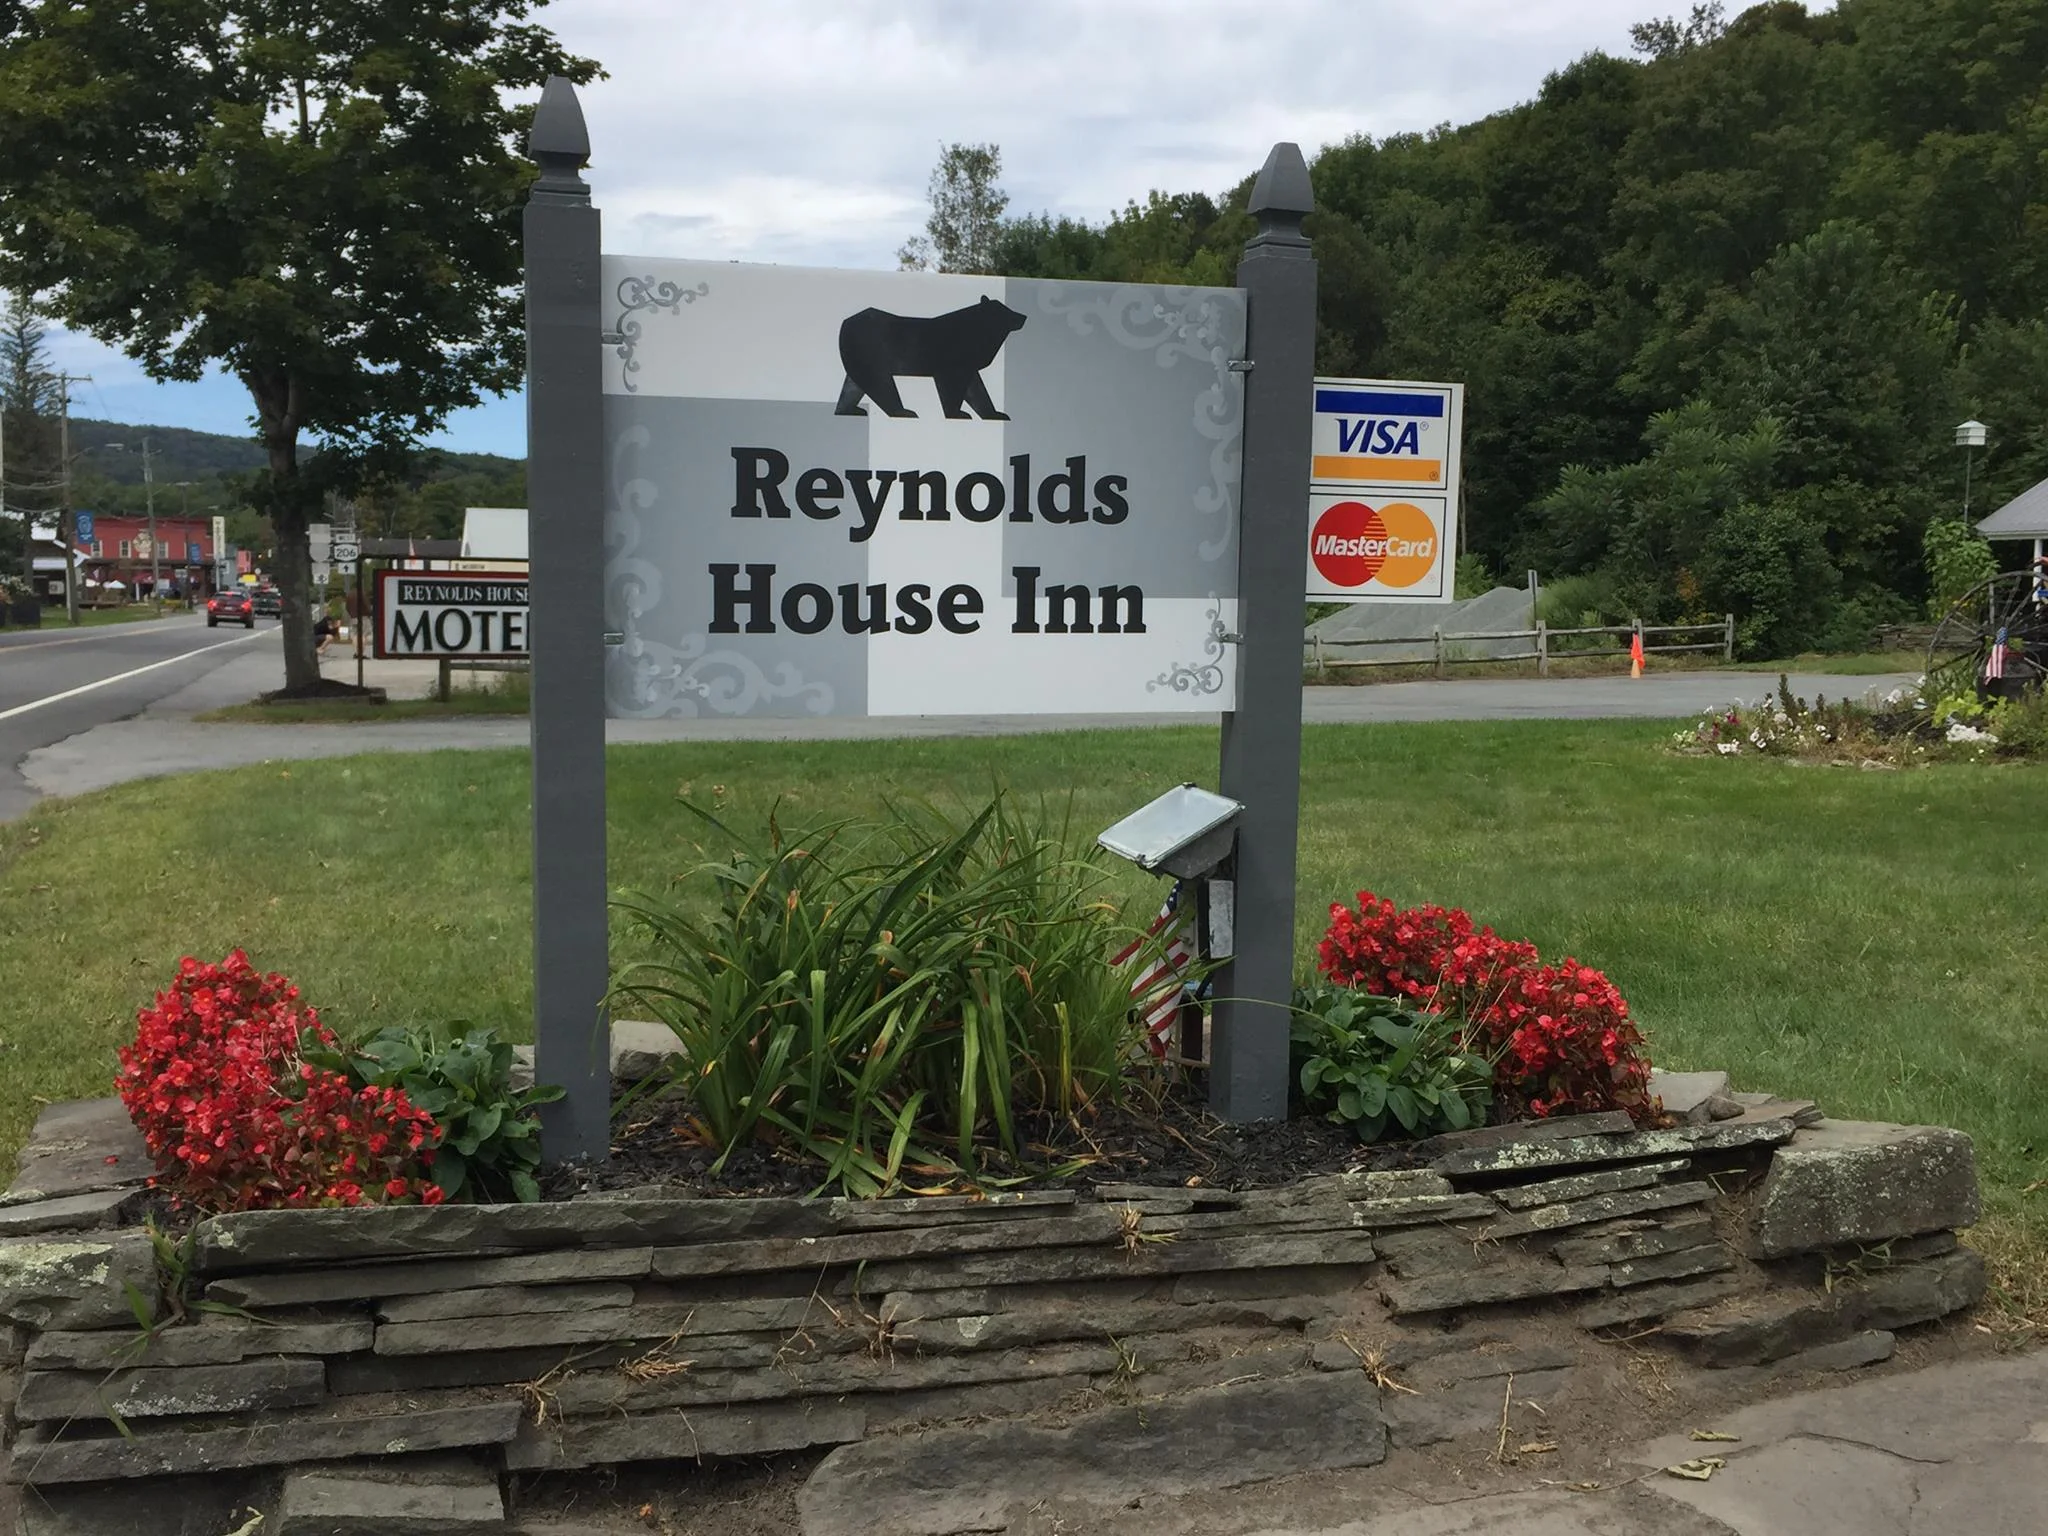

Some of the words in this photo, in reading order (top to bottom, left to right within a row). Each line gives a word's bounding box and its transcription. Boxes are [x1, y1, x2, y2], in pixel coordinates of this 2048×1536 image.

[1335, 418, 1419, 455] VISA
[731, 447, 1129, 543] Reynolds
[336, 548, 357, 558] 206
[1315, 534, 1433, 558] MasterCard
[403, 585, 482, 601] REYNOLDS
[708, 563, 984, 634] House
[1011, 566, 1147, 634] Inn
[390, 608, 530, 652] MOTE
